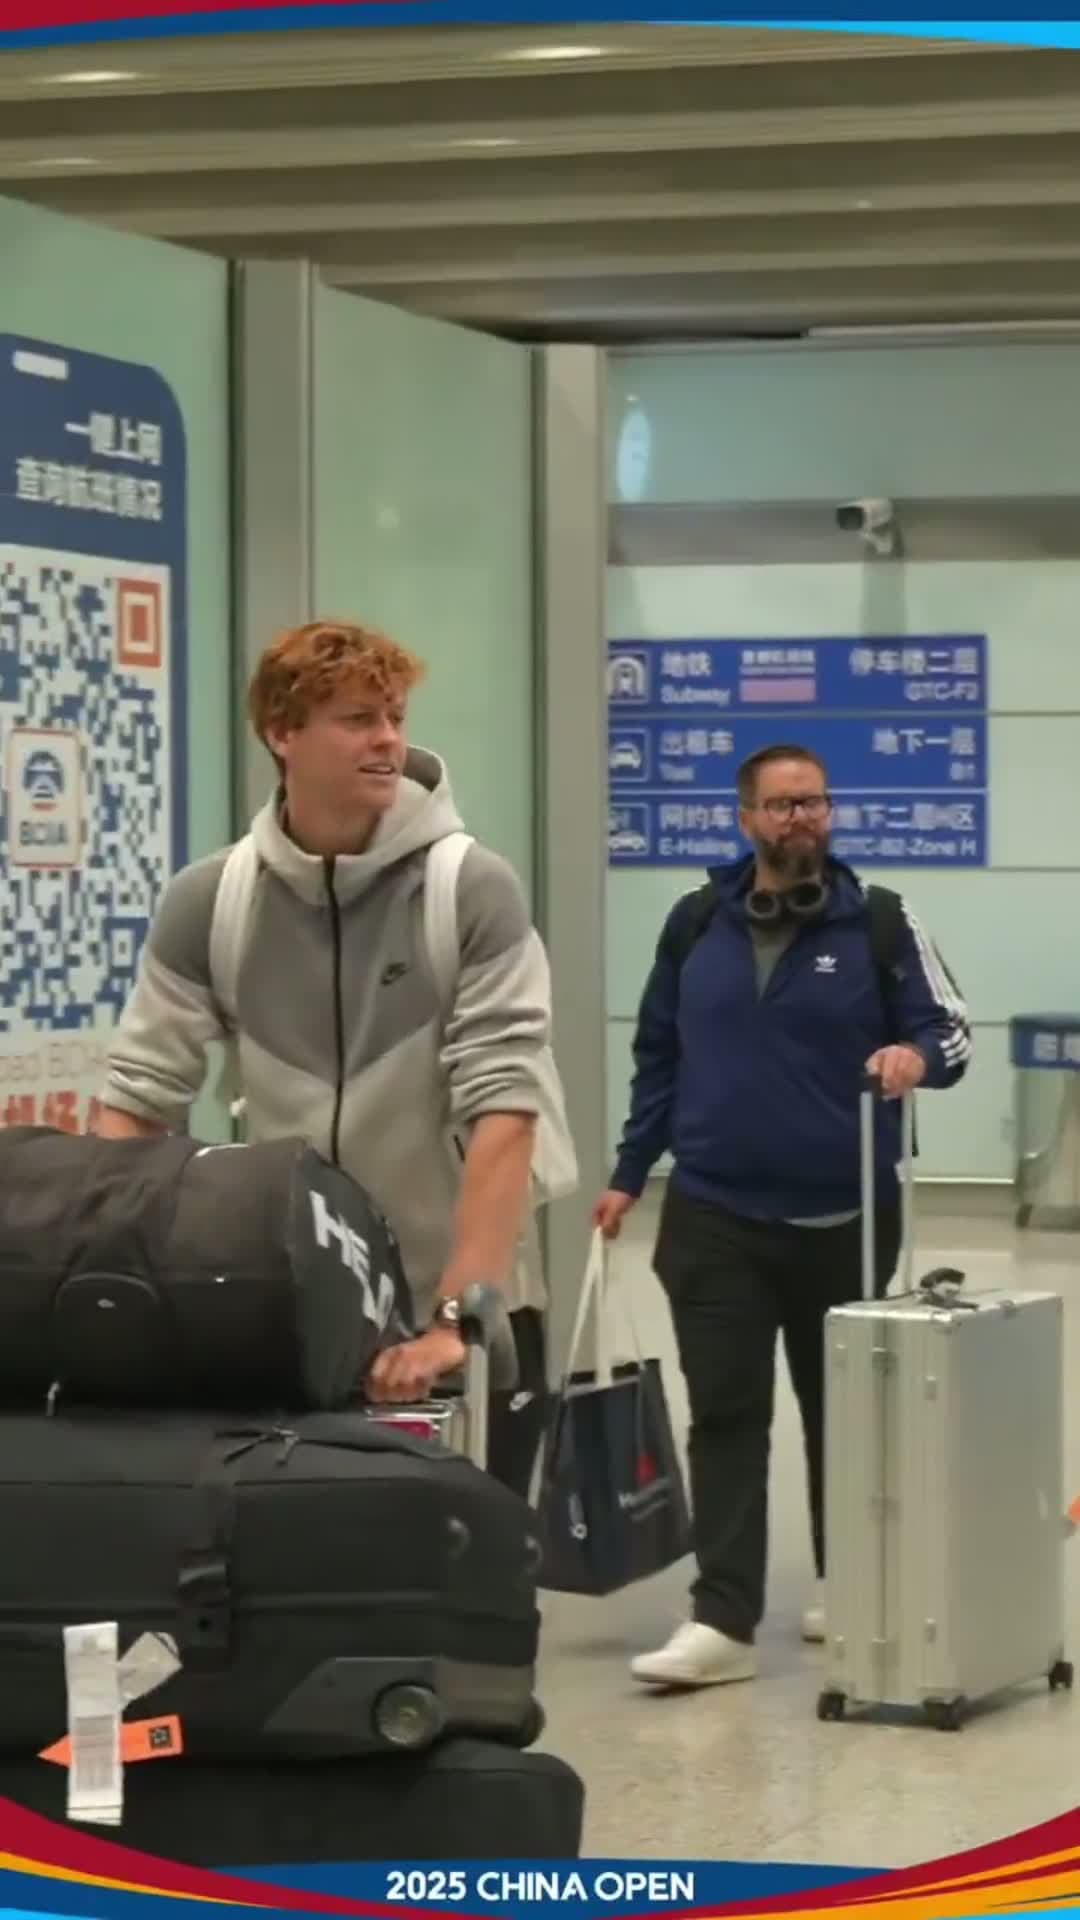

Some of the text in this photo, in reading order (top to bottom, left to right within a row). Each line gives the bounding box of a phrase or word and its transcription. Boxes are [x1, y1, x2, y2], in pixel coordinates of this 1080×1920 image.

[16, 457, 162, 521] 查询航班情况
[661, 685, 731, 707] Subway
[872, 728, 976, 755] 地下一层
